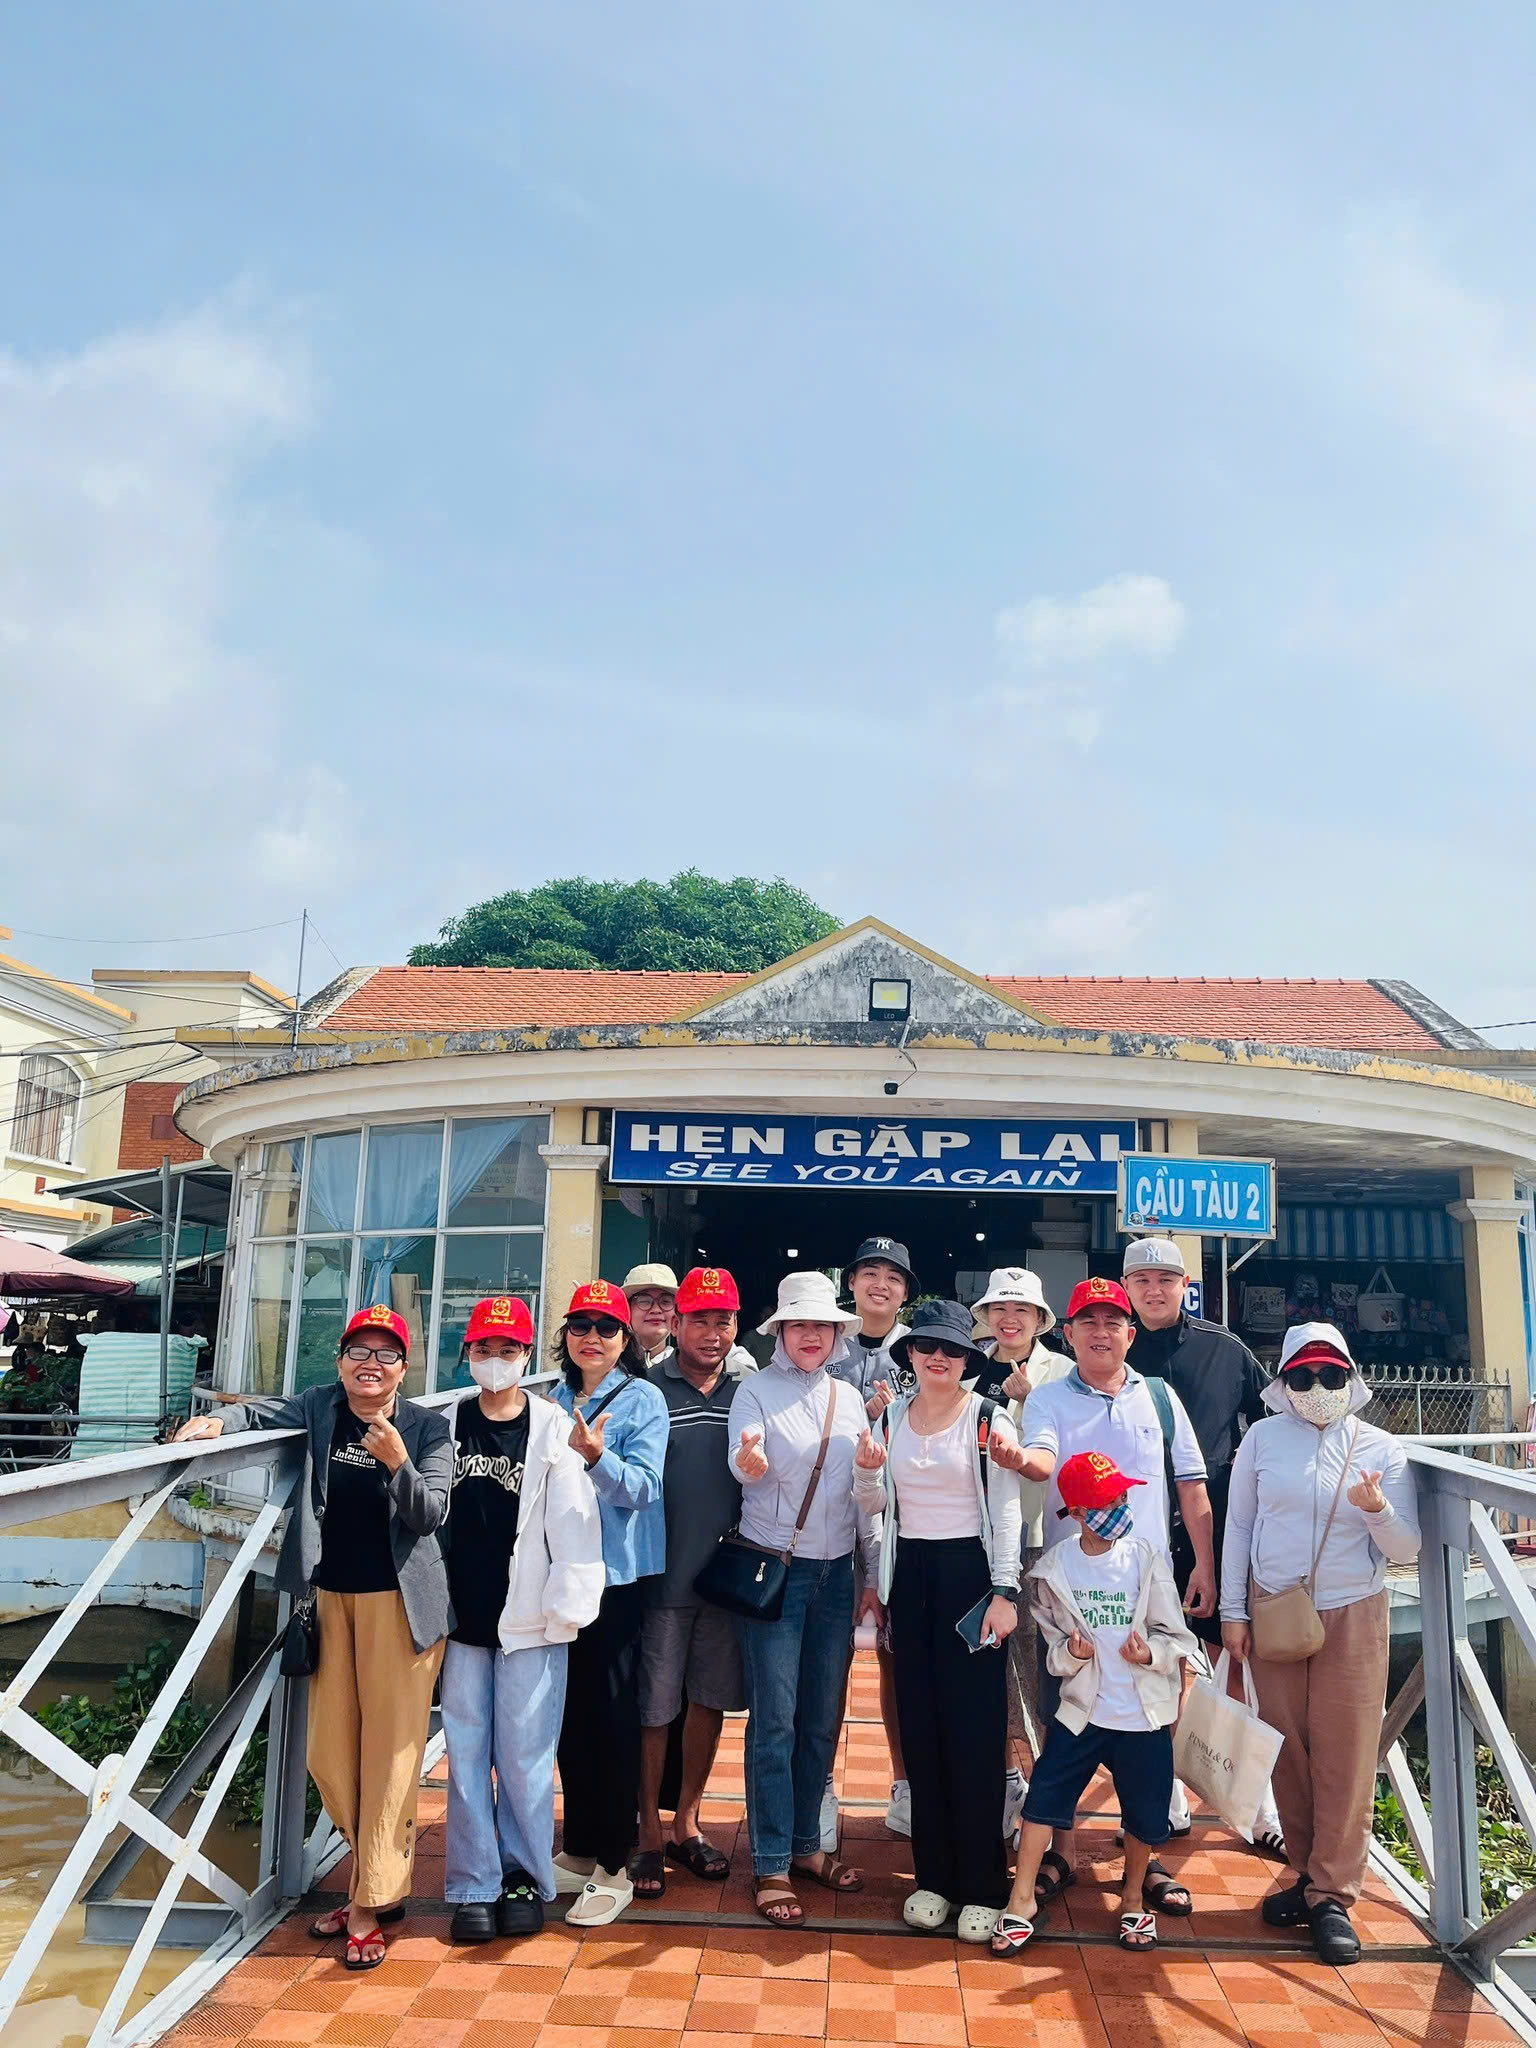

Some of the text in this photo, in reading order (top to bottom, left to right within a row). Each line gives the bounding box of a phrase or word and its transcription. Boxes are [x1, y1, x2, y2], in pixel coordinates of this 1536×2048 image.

[630, 1123, 1120, 1168] HẸN GẶP LẠI
[665, 1161, 1082, 1186] SEE YOU AGAIN
[1135, 1165, 1261, 1221] CẦU TÀU 2
[1184, 1286, 1199, 1312] C
[335, 1448, 376, 1465] intention
[453, 1454, 524, 1496] UNWA
